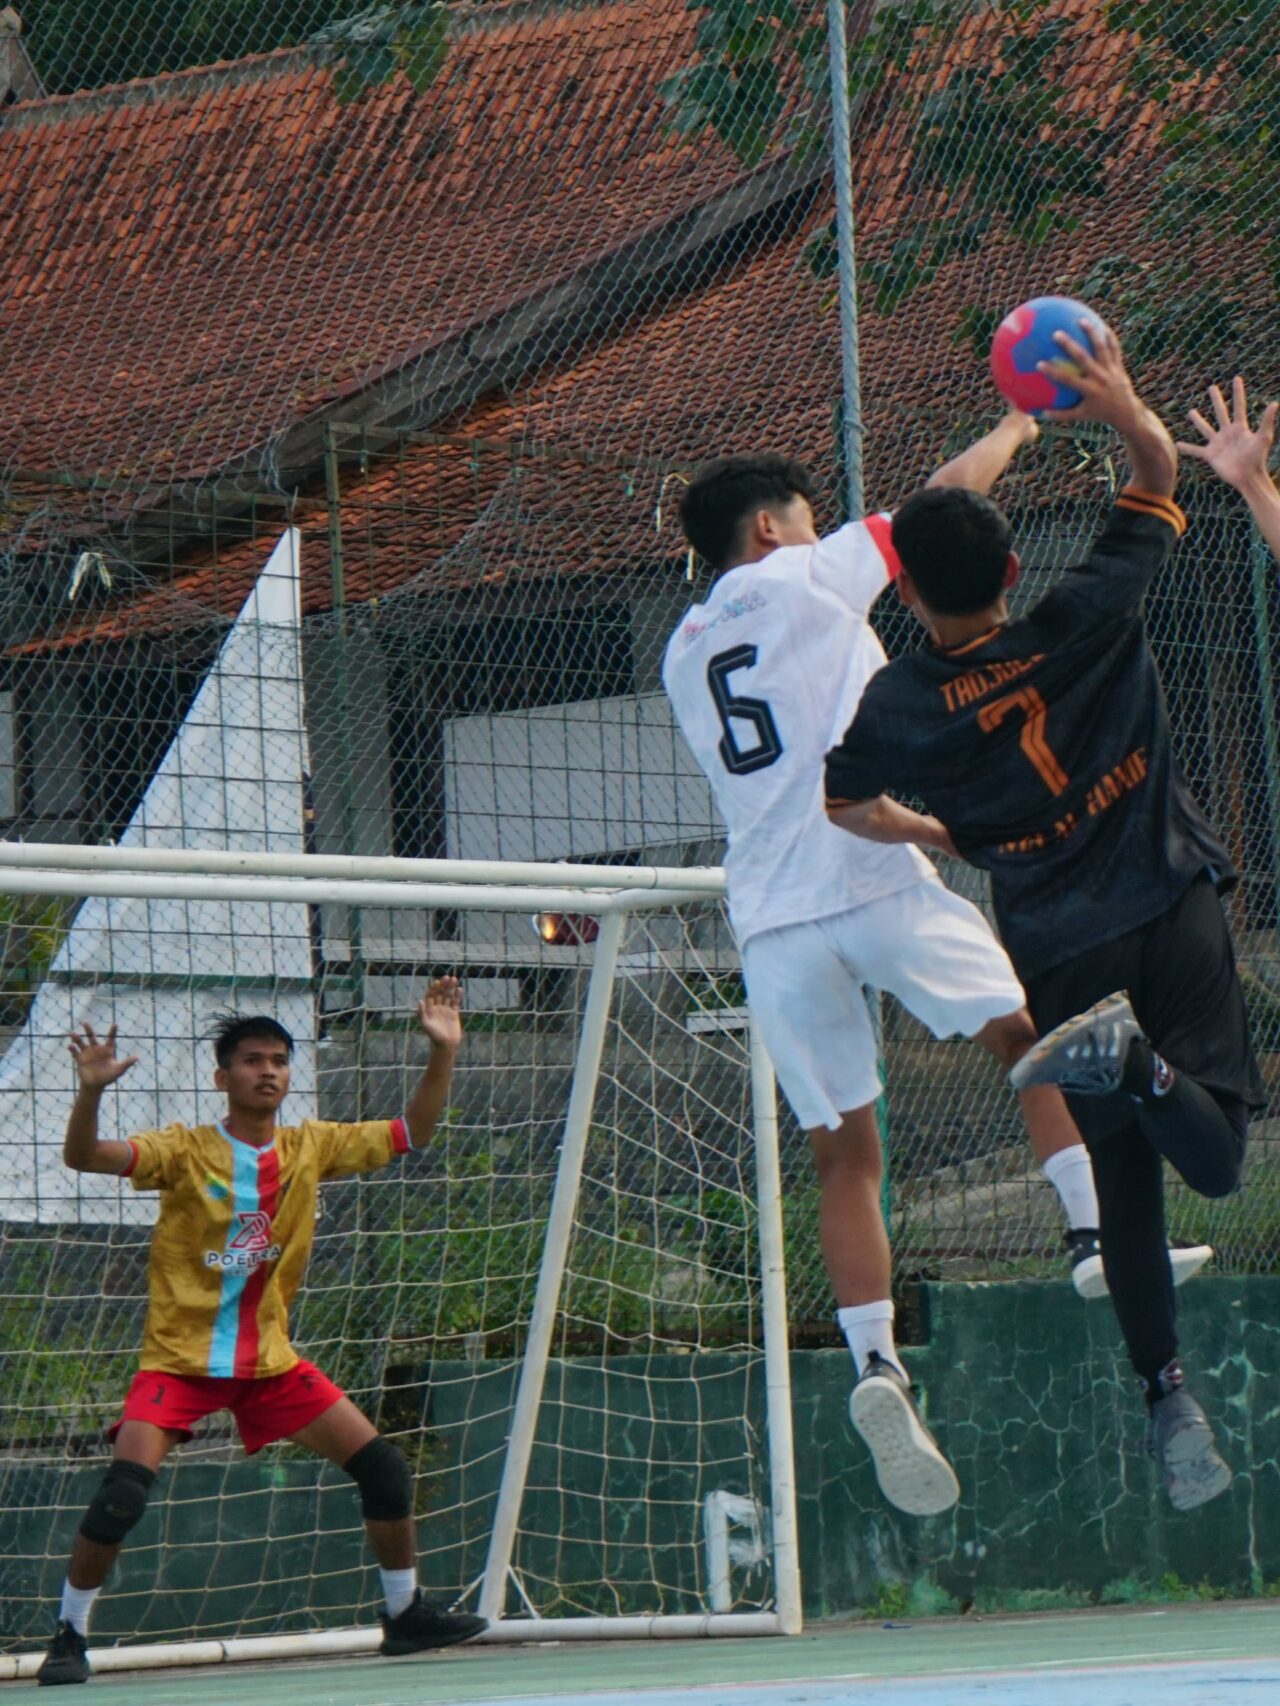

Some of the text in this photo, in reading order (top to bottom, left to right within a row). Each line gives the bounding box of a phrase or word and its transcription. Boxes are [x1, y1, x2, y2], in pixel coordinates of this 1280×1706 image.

[706, 642, 783, 775] 6
[977, 685, 1070, 797] 7
[206, 1246, 281, 1266] POETRA
